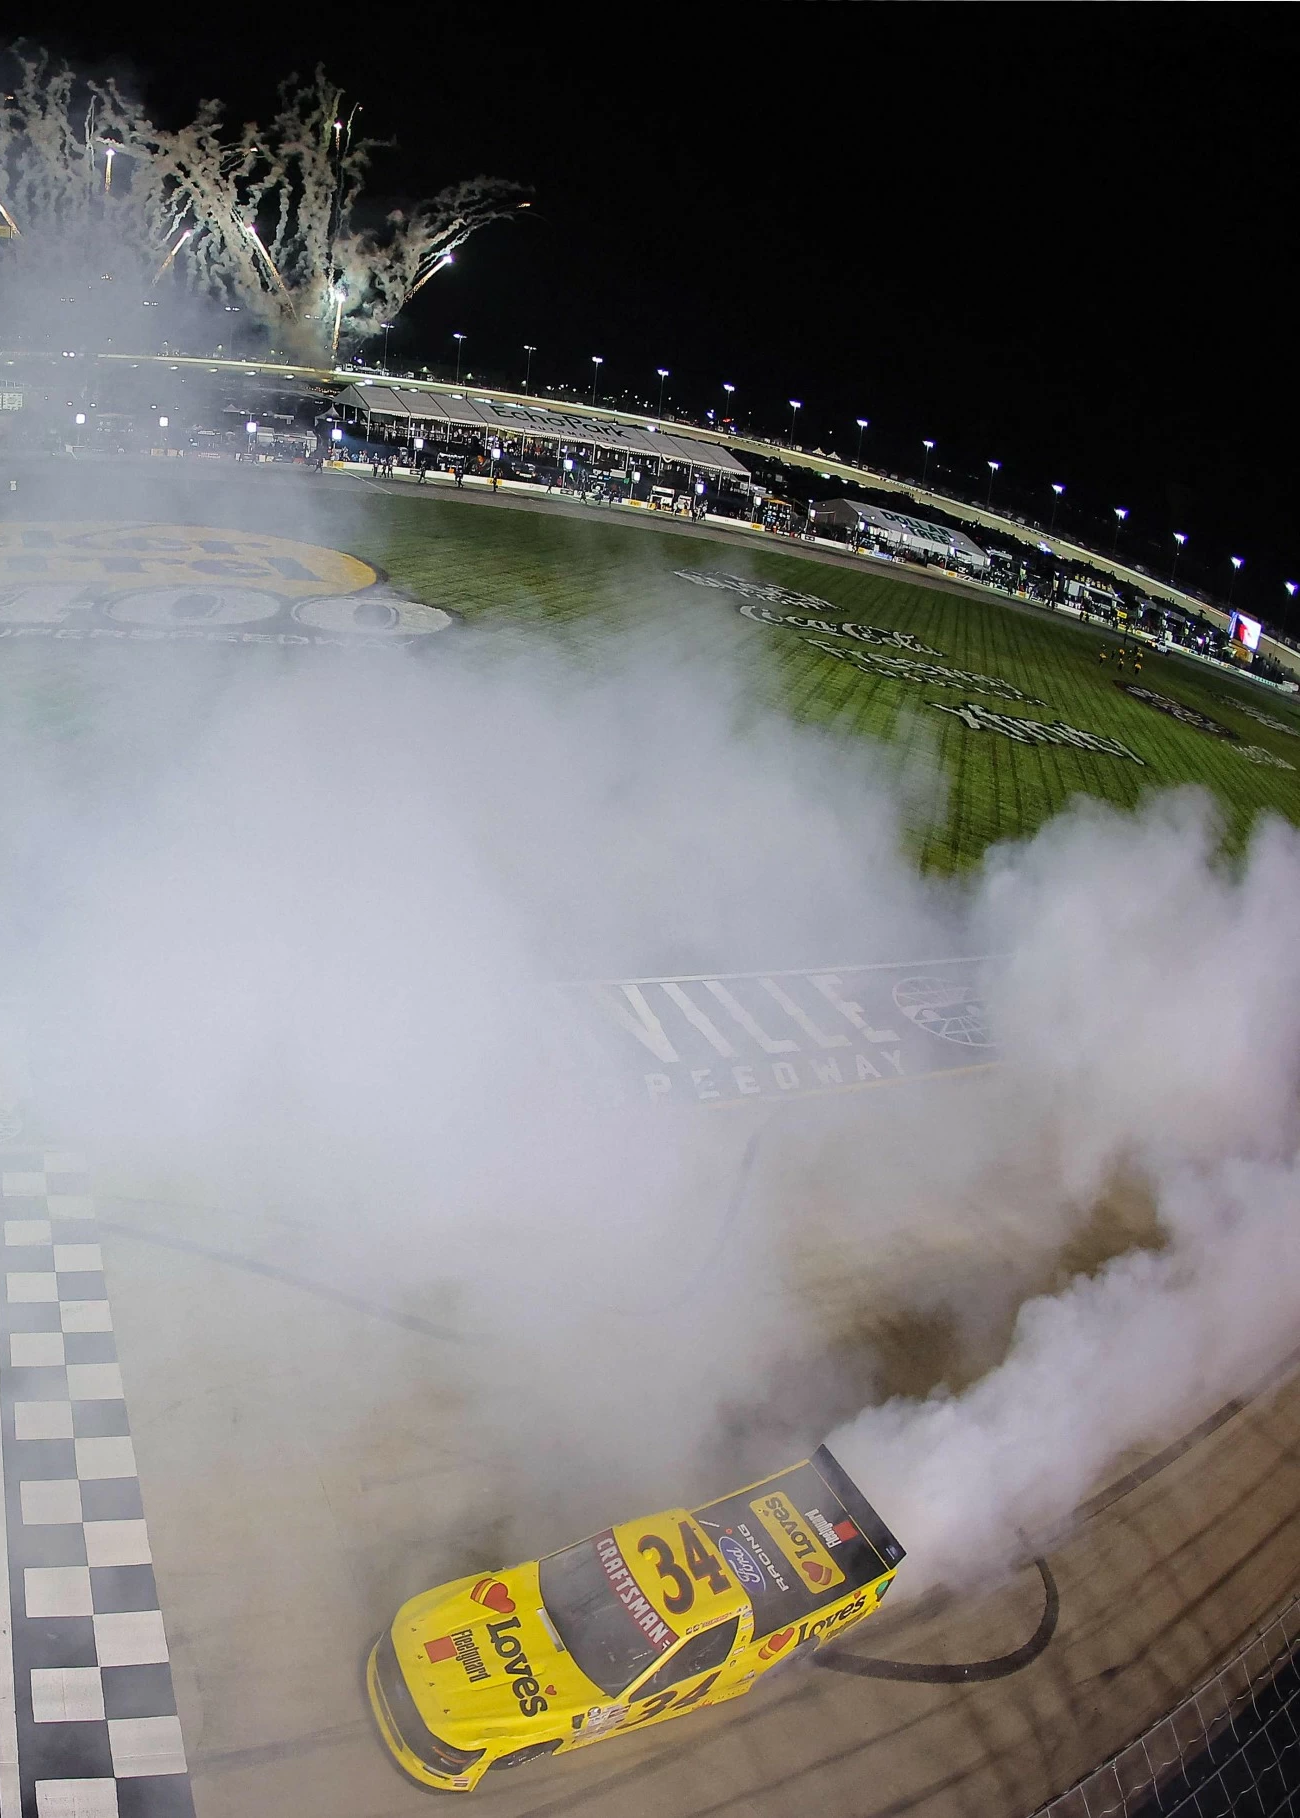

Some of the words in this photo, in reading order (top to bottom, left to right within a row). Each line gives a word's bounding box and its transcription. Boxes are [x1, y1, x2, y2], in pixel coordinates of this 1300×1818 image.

[489, 405, 631, 440] EchoPark
[880, 510, 954, 540] DOLLAR
[908, 525, 951, 545] TREE
[610, 973, 901, 1064] VILLE
[642, 1048, 907, 1101] PEEDWAY
[804, 1508, 842, 1549] Fleetguard
[637, 1521, 732, 1614] 34
[726, 1546, 762, 1585] Ford
[737, 1523, 790, 1592] RACING
[596, 1537, 669, 1644] CRAFTSMAN
[450, 1629, 492, 1684] Fleetguard
[615, 1670, 723, 1731] 34
